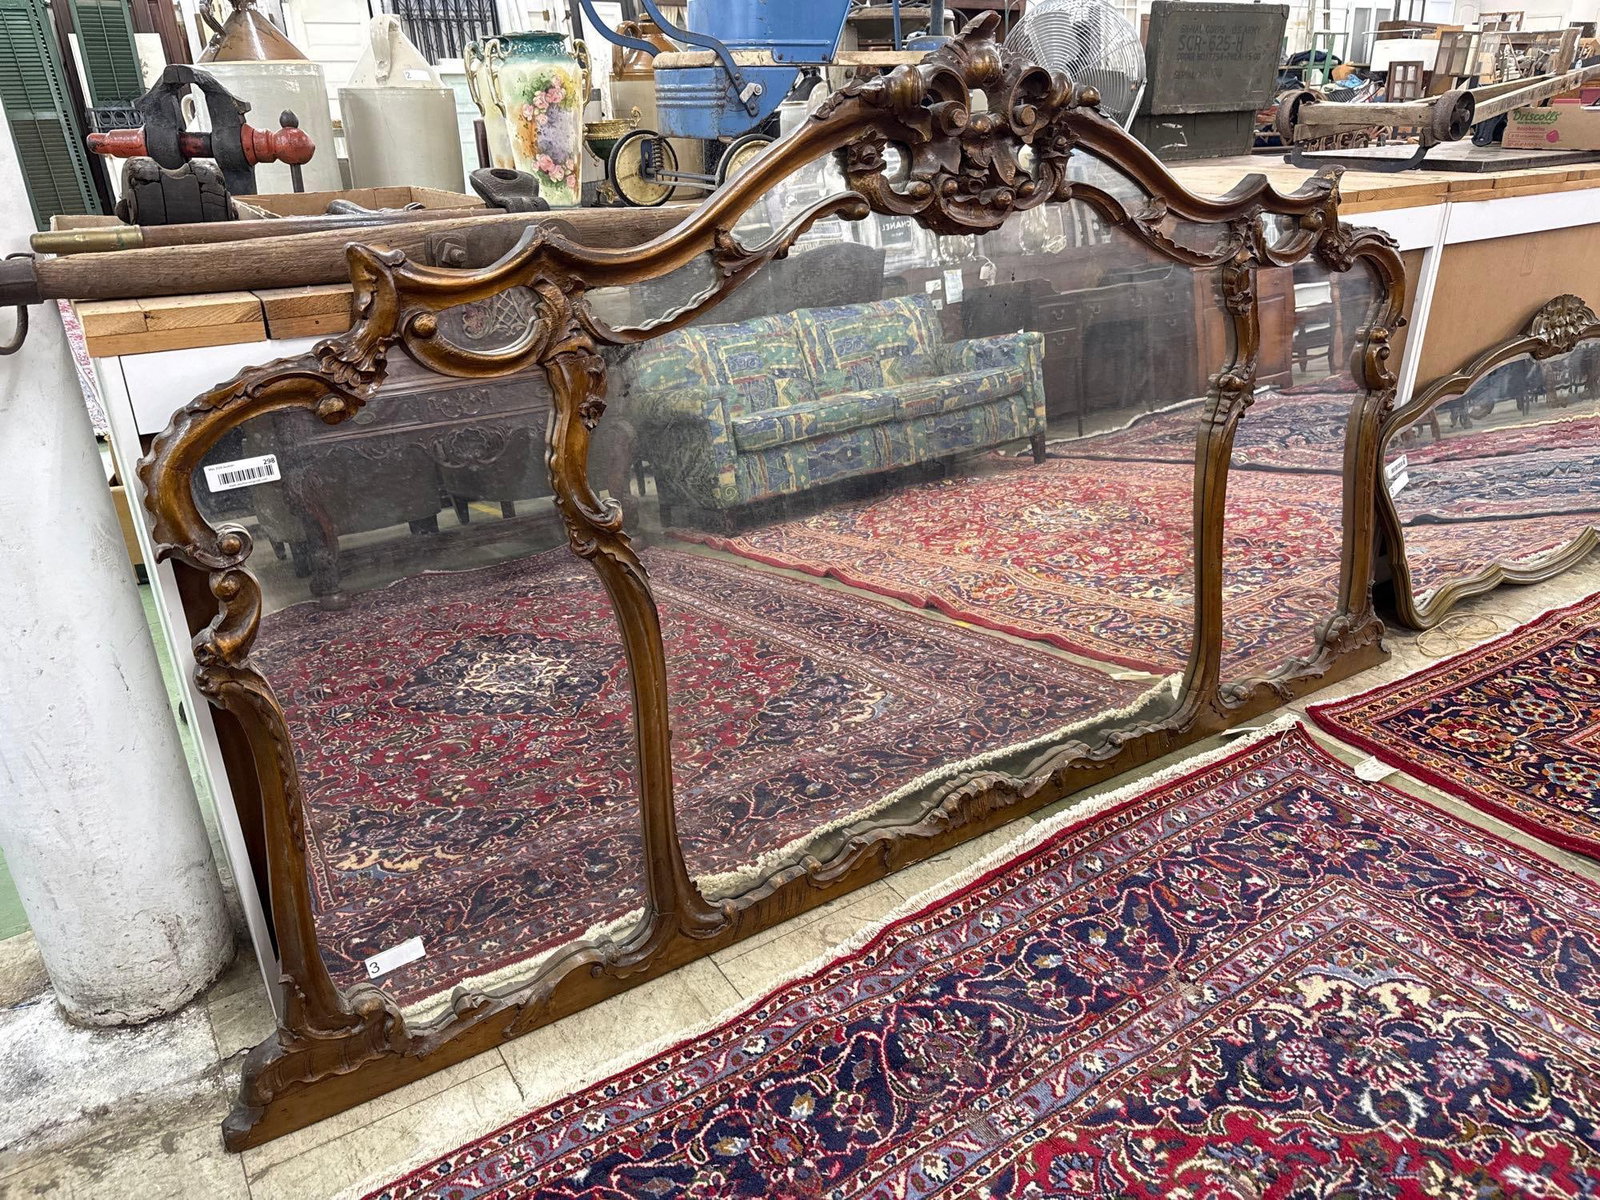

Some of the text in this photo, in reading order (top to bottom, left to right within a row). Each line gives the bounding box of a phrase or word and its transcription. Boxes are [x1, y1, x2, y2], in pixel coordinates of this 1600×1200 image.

[1178, 34, 1245, 52] SCR-625-H
[1513, 110, 1559, 122] Driscoll's
[369, 961, 380, 974] 3
